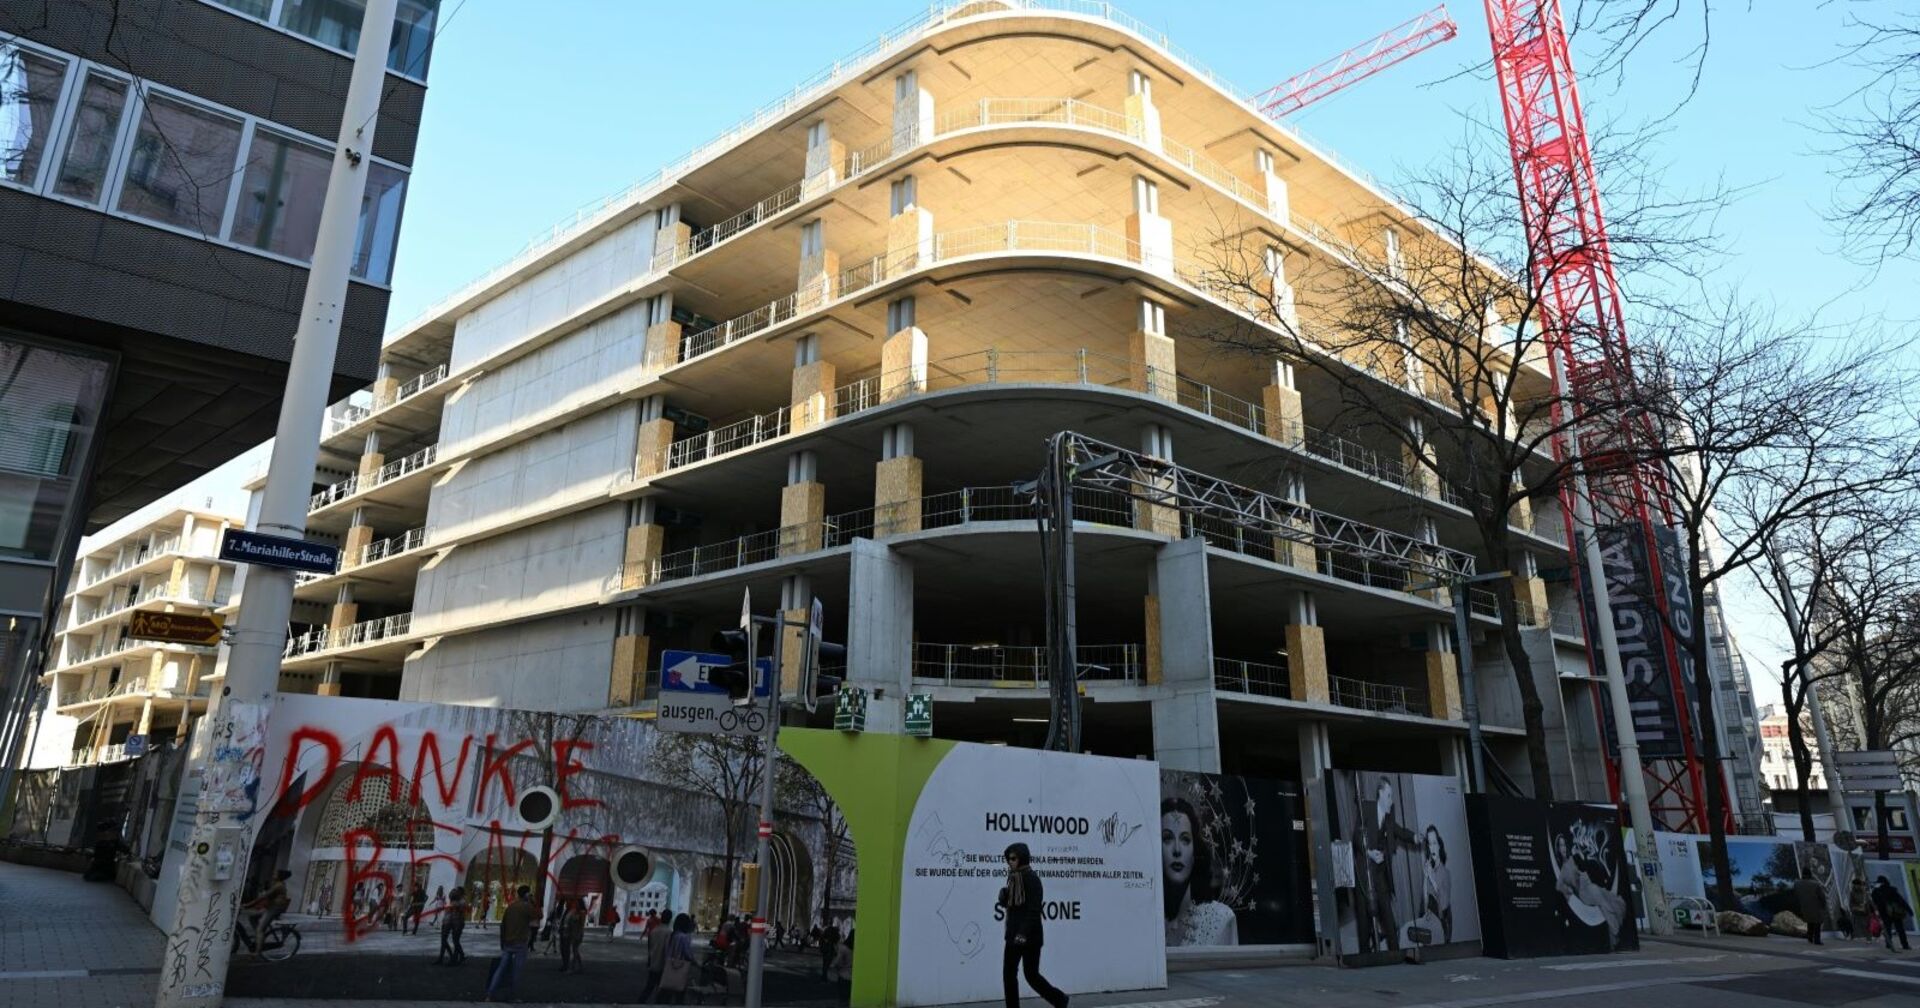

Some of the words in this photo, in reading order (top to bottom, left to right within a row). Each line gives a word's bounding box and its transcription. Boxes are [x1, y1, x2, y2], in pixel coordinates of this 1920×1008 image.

[241, 540, 300, 560] Mariahilfer
[300, 550, 333, 565] Straße
[662, 704, 719, 723] ausgen.
[277, 724, 606, 818] DANKE
[986, 812, 1089, 835] HOLLYWOOD
[966, 854, 977, 863] SIE
[979, 854, 1006, 863] WOLLTE
[915, 868, 928, 877] SIE
[929, 868, 957, 877] WURDE
[976, 869, 991, 878] DER
[1102, 870, 1122, 880] ALLER
[1675, 909, 1687, 922] P
